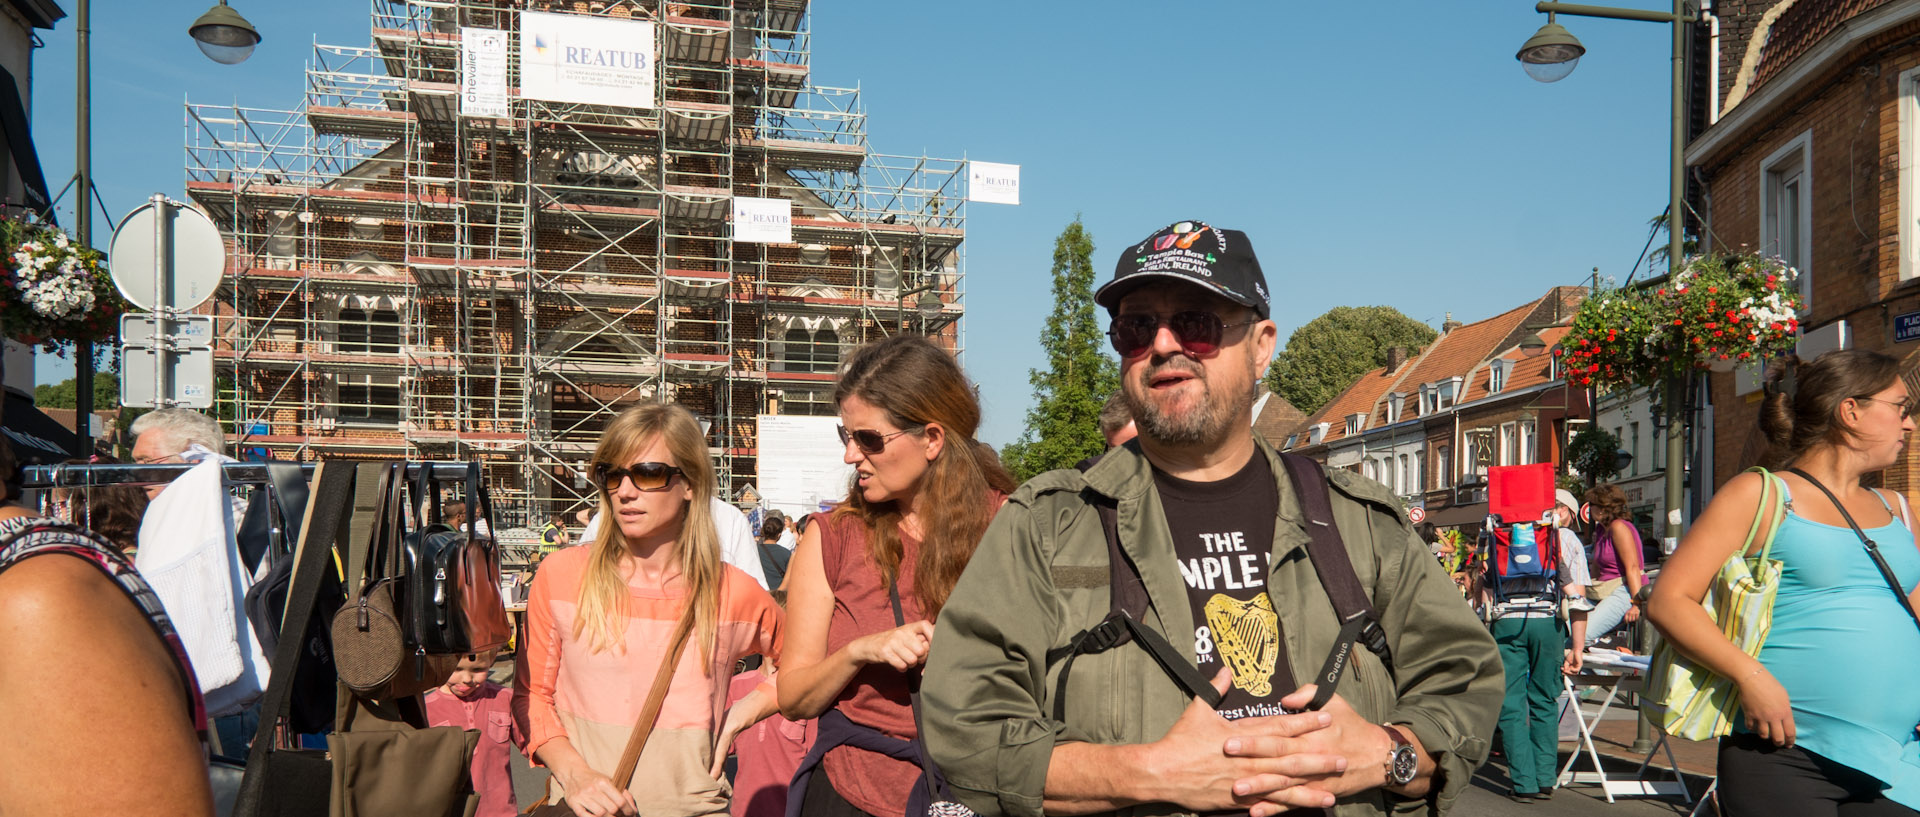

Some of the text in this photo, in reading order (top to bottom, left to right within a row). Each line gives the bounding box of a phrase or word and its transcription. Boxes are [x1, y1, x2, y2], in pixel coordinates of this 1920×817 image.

[565, 46, 647, 70] REATUB
[465, 49, 476, 103] chevalier
[986, 177, 1017, 187] REATUB
[753, 214, 788, 224] REATUB
[1147, 249, 1184, 260] Temple
[1172, 261, 1212, 277] IRELAND
[1199, 531, 1248, 553] THE
[1327, 642, 1349, 684] Quechua
[1245, 701, 1294, 717] Whisk
